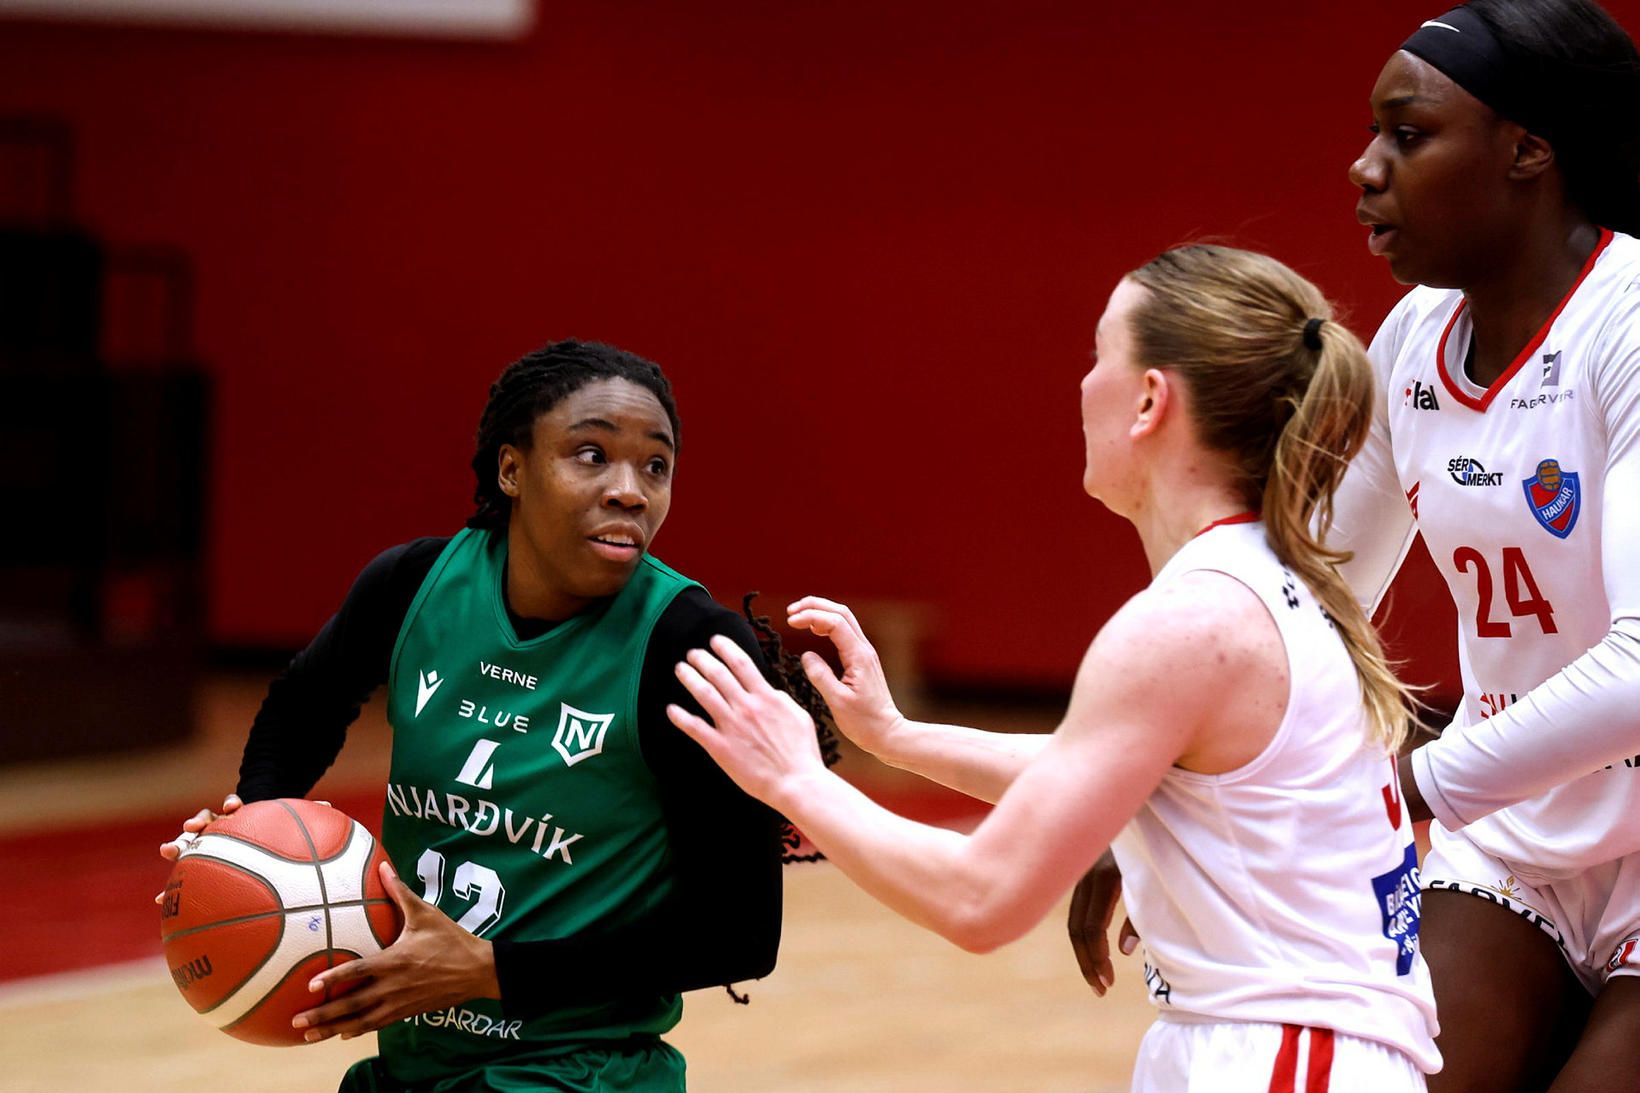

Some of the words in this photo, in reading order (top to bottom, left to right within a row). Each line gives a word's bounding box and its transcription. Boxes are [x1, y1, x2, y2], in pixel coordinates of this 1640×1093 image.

[1447, 455, 1469, 472] SÉR
[1466, 472, 1504, 487] MERKT
[1541, 487, 1573, 520] HAUKAR
[1453, 546, 1559, 638] 24
[480, 661, 538, 690] VERNE
[458, 699, 530, 734] BLUE
[387, 783, 585, 865] NJARÐVÍK
[416, 848, 506, 937] 12
